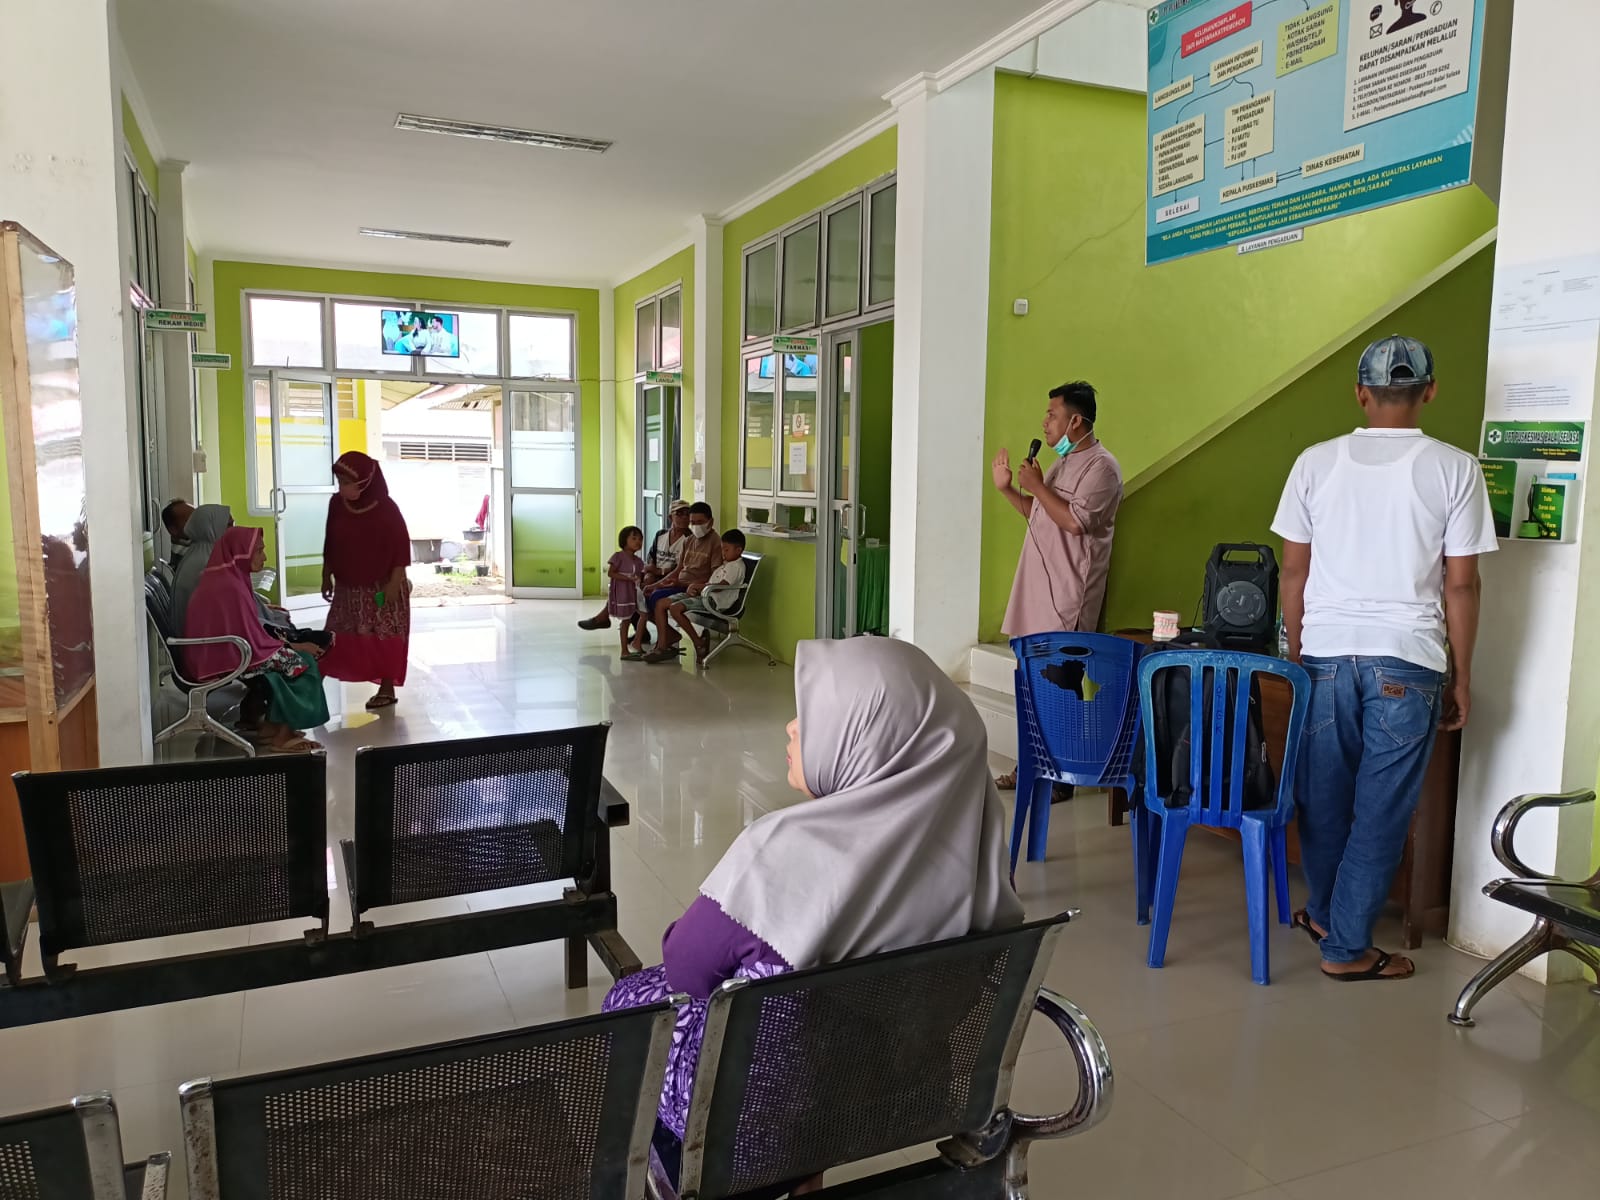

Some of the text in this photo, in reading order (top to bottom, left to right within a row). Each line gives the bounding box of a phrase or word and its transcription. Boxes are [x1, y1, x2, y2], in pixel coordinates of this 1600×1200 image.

[1285, 5, 1334, 32] TIDAK LANGSUNG
[1359, 18, 1459, 63] KELUHAN/SARAN/PENGADUAN
[1359, 29, 1458, 73] DAPAT DISAMPAIKAN MELALUI
[1236, 107, 1265, 123] PENGADUAN
[1305, 149, 1360, 173] DINAS KESEHATAN
[1367, 173, 1380, 184] ADA
[1381, 164, 1411, 180] KUALITAS
[1411, 154, 1444, 171] LAYANAN
[1222, 176, 1274, 199] KEPALA PUSKESMAS
[1165, 203, 1190, 217] SELESAI
[158, 319, 182, 327] REKAM
[787, 344, 811, 352] FARMASI
[1514, 430, 1544, 444] PUSKESMAS
